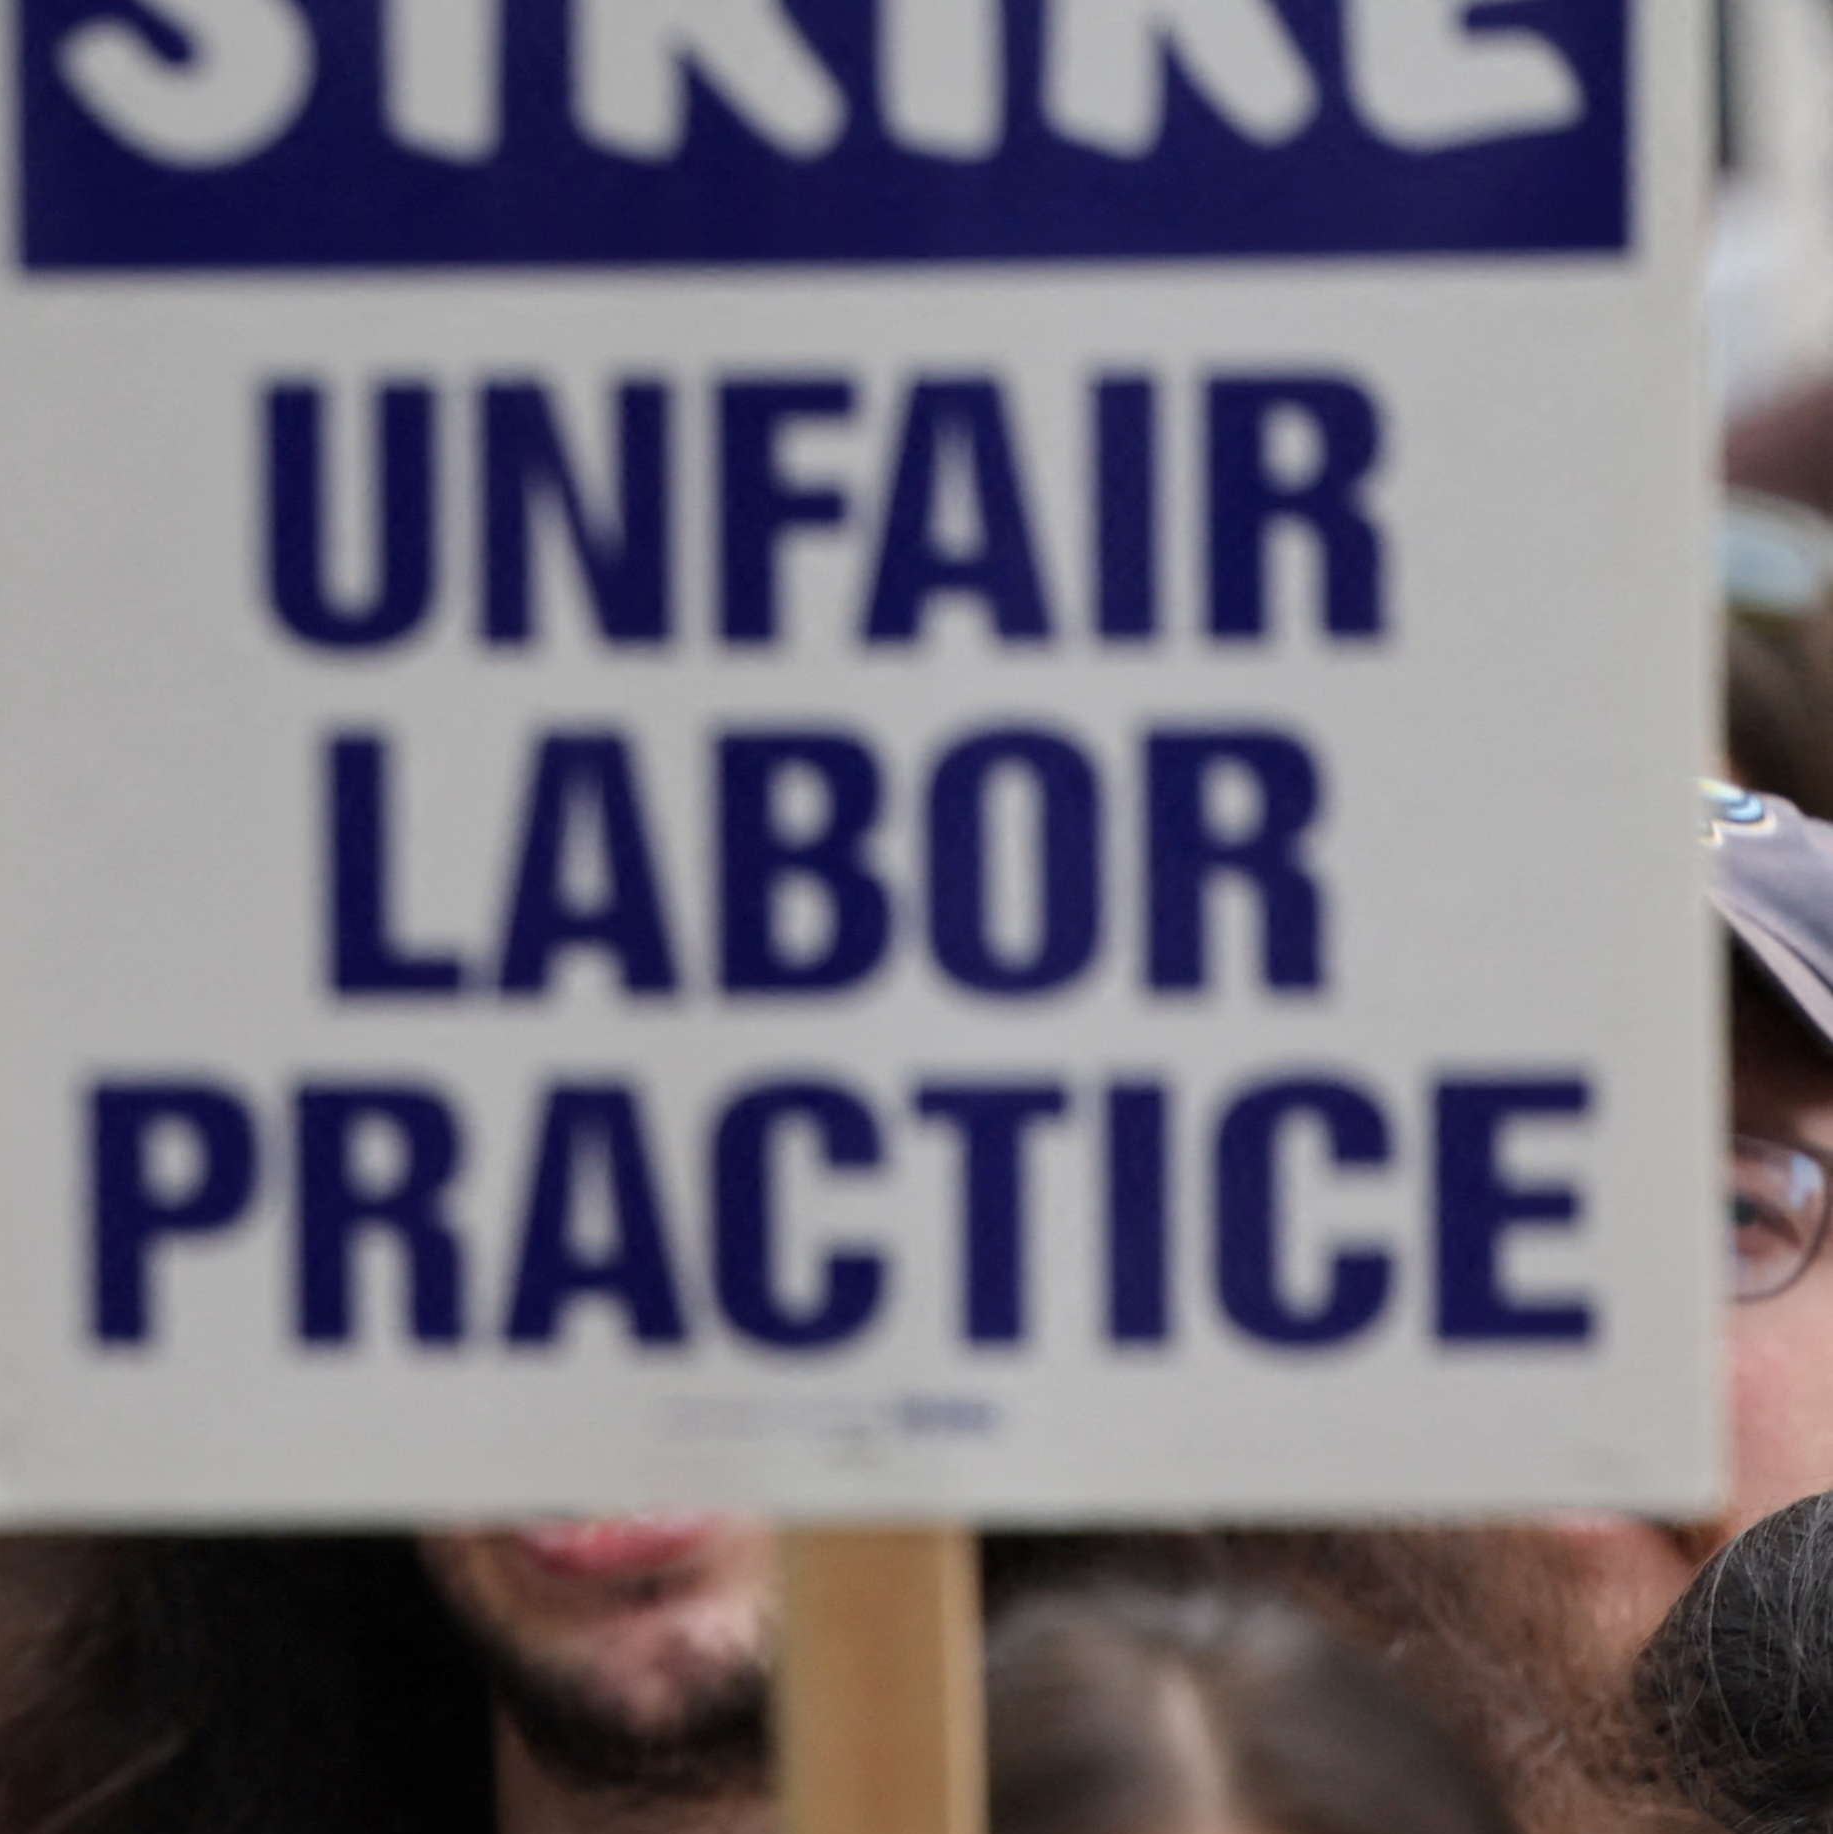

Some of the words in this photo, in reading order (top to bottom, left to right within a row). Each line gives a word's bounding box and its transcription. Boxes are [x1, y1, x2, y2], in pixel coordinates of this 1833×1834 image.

[259, 372, 1387, 655] UNFAIR
[322, 724, 1326, 1001] LABOR
[84, 1073, 1596, 1356] PRACTICE
